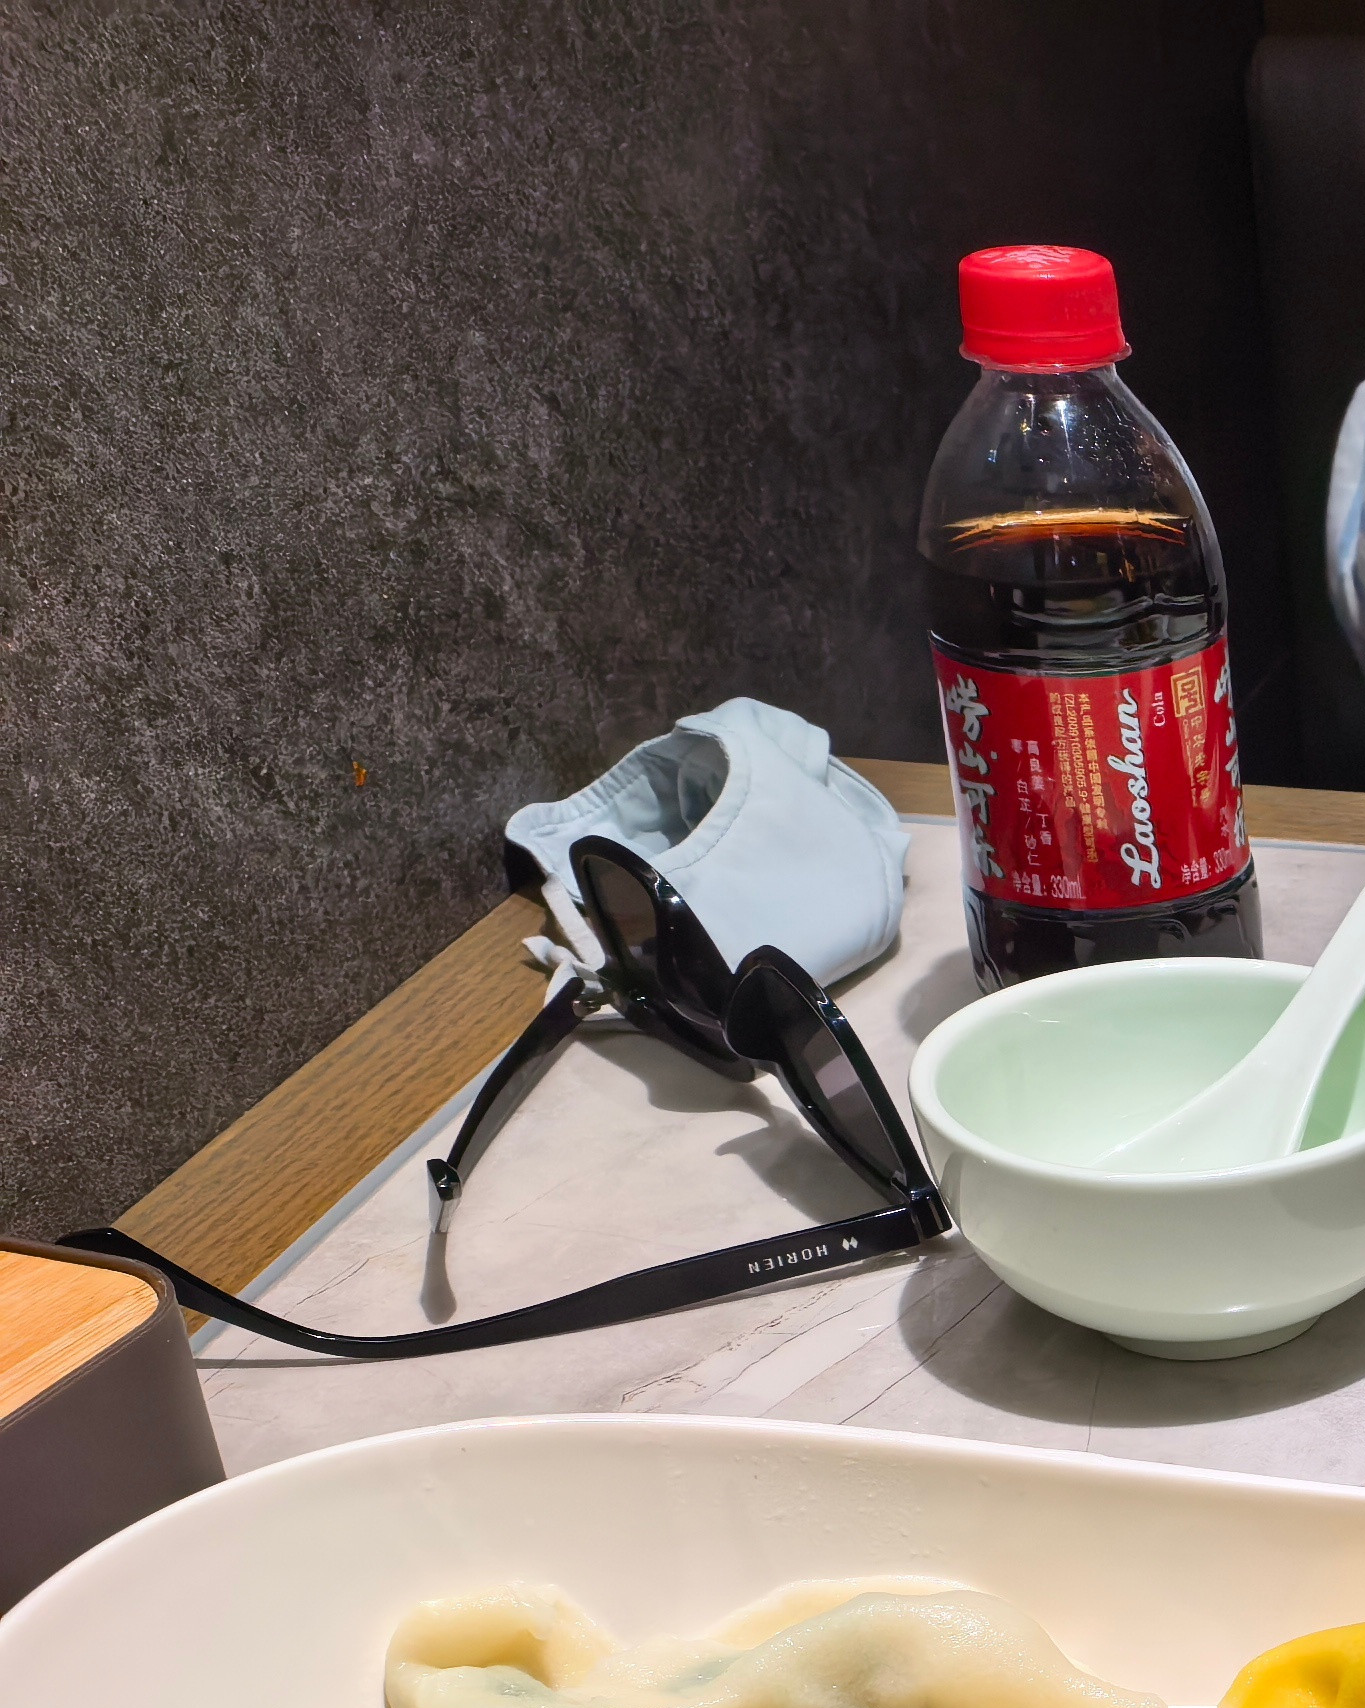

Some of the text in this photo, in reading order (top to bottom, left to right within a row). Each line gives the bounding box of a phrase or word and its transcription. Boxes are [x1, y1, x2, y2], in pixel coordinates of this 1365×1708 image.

[1153, 691, 1166, 728] Cola
[1107, 687, 1163, 889] Laoshan
[748, 1244, 828, 1275] HORIEN
